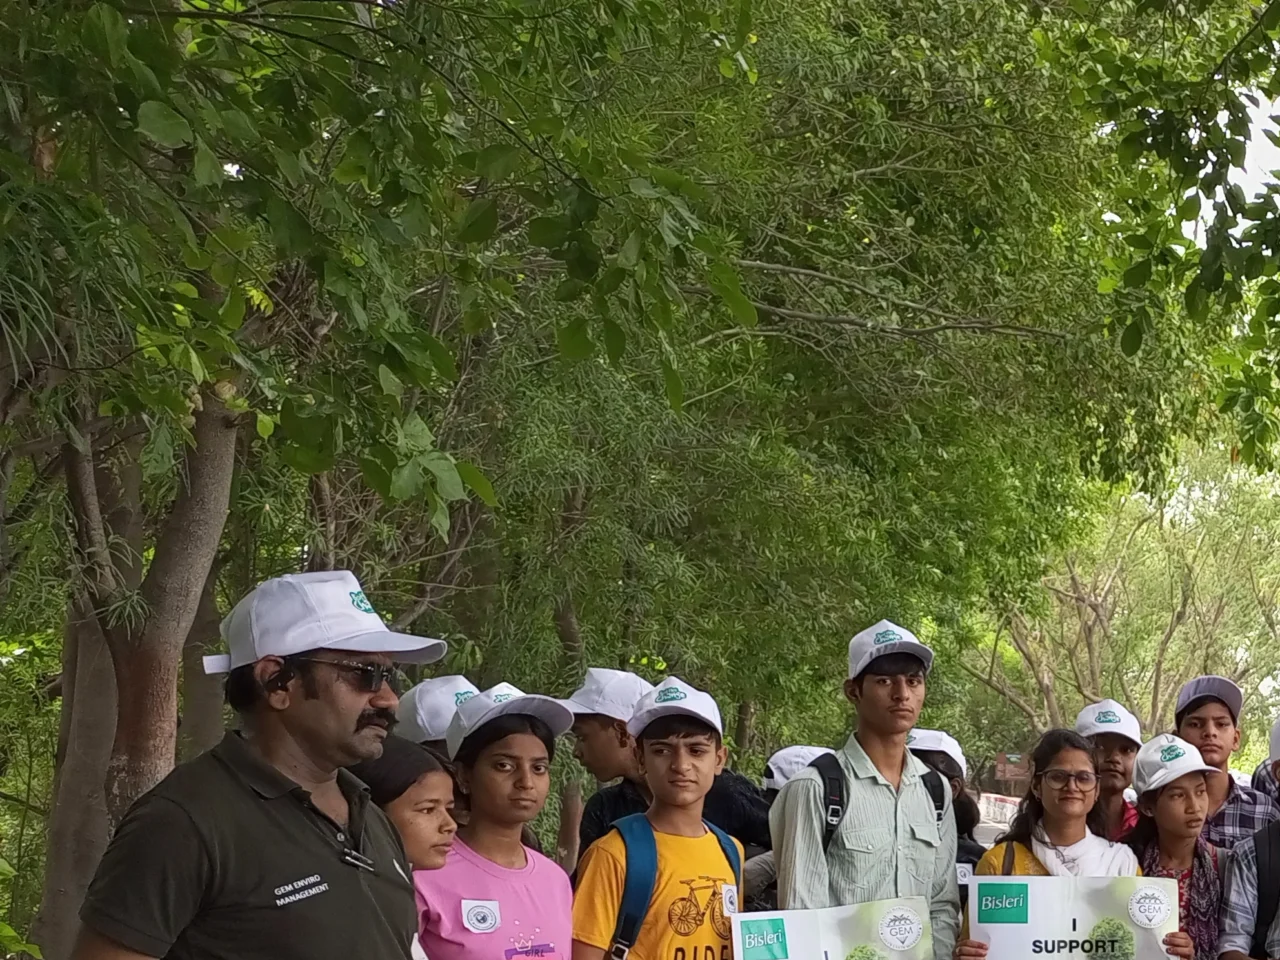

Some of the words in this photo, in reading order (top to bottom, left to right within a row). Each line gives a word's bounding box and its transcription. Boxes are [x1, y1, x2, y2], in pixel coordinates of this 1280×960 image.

[274, 884, 294, 895] GEM
[293, 874, 321, 889] ENVIRO
[276, 882, 329, 906] MANAGEMENT
[981, 894, 1024, 911] Bisleri
[1138, 904, 1162, 914] GEM
[889, 926, 914, 937] GEM
[1072, 918, 1077, 932] I
[745, 929, 783, 949] Bisleri
[1032, 939, 1119, 954] SUPPORT
